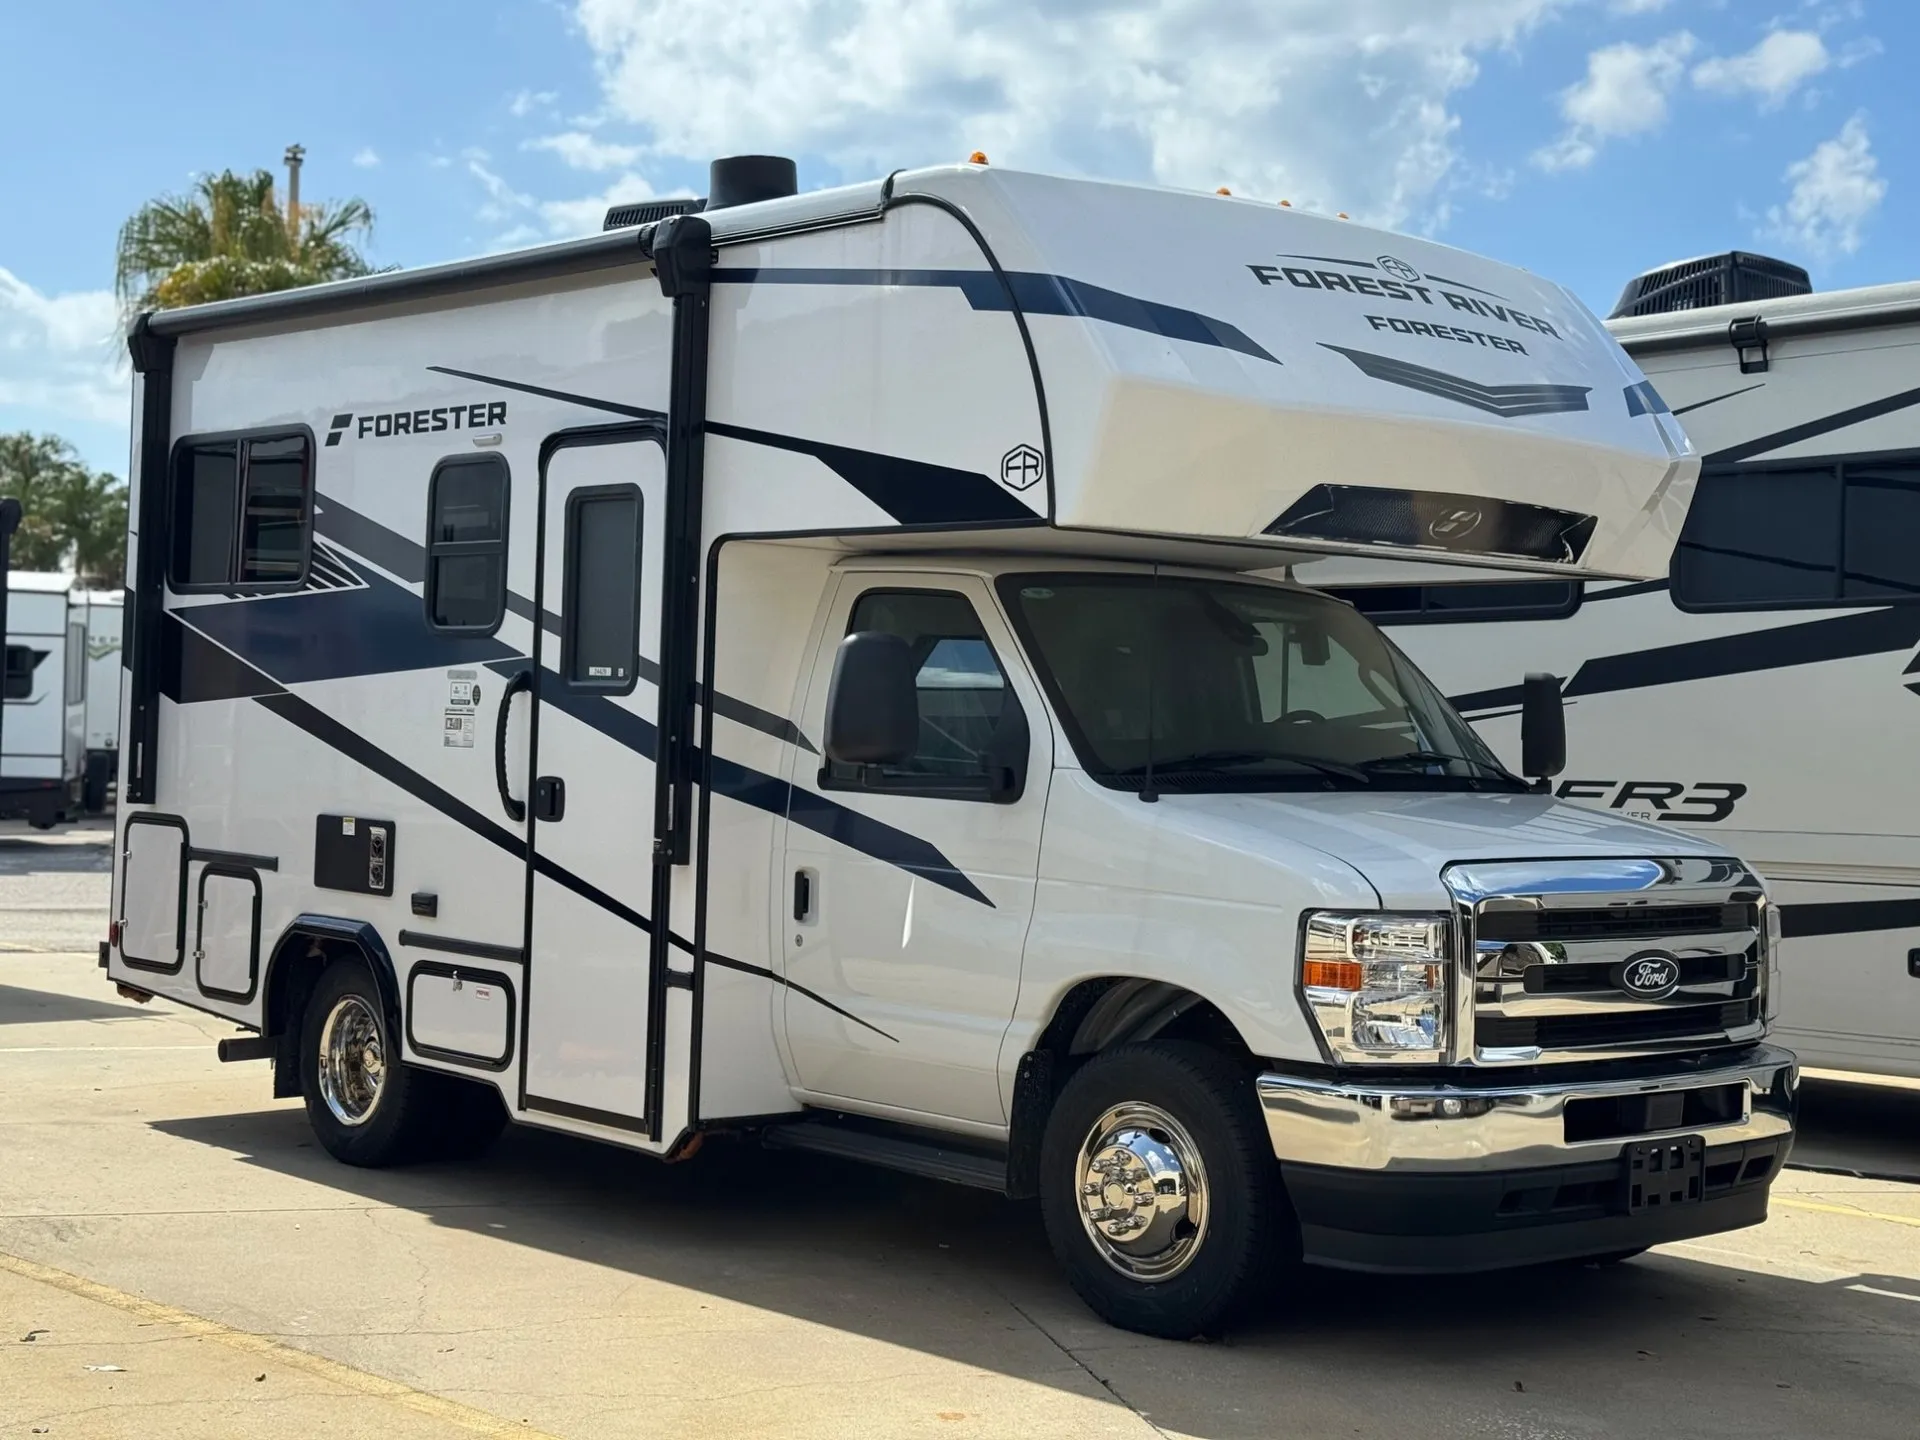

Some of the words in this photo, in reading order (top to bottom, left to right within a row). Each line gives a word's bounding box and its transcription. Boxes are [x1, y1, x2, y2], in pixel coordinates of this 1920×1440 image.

[1245, 264, 1433, 305] FOREST
[1438, 290, 1564, 341] RIVER
[1363, 314, 1530, 356] FORESTER
[358, 401, 507, 439] FORESTER
[1004, 448, 1040, 486] FR
[1554, 780, 1747, 822] FR3
[1634, 962, 1669, 986] Ford
